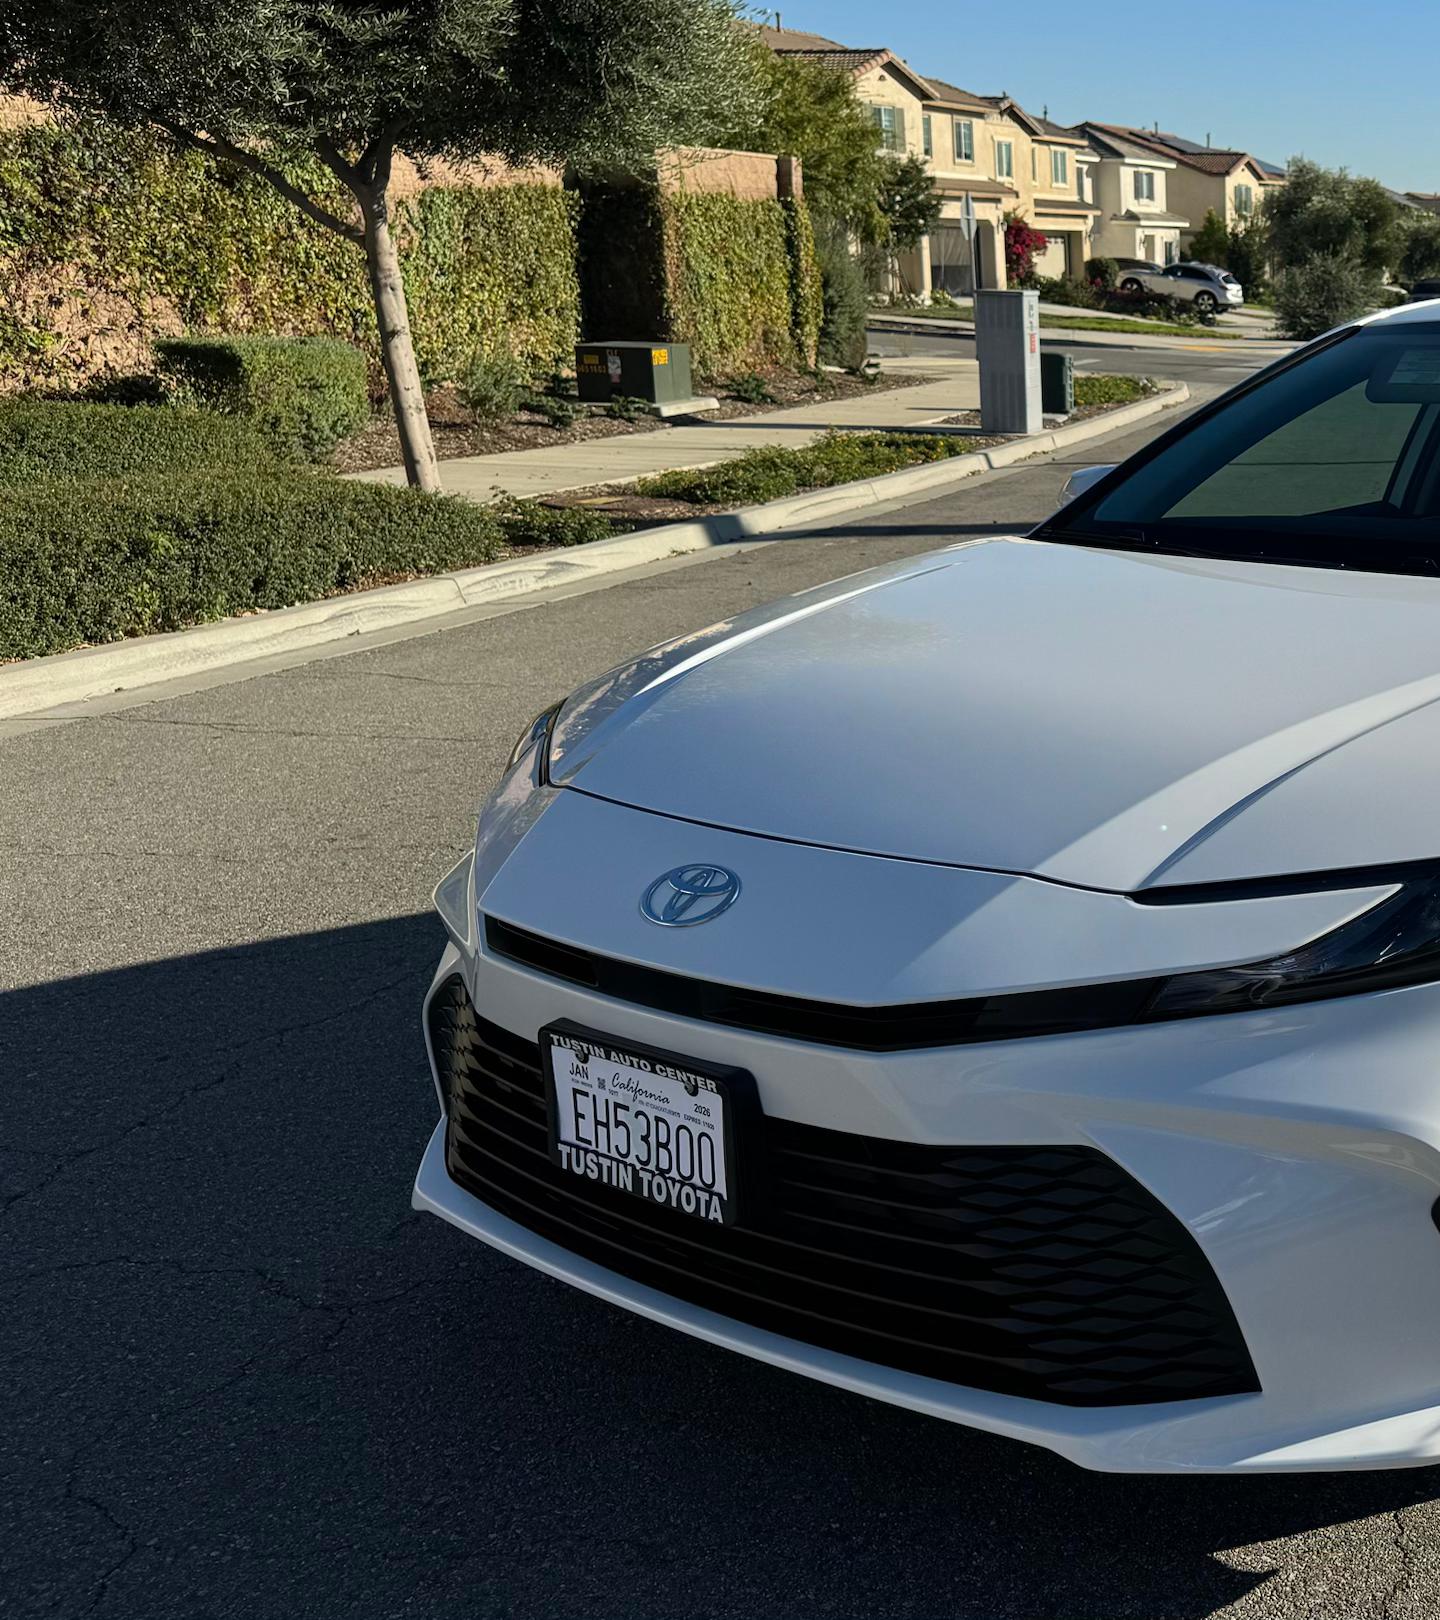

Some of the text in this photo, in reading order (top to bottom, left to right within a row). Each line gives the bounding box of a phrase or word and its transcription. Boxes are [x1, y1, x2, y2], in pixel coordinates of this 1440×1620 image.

[549, 1033, 719, 1094] TUSTIN AUTO CENTER
[569, 1062, 589, 1080] JAN
[611, 1072, 671, 1105] California
[693, 1103, 711, 1117] 2026
[572, 1087, 716, 1189] EH53B00
[557, 1142, 724, 1225] TUSTIN TOYOTA
